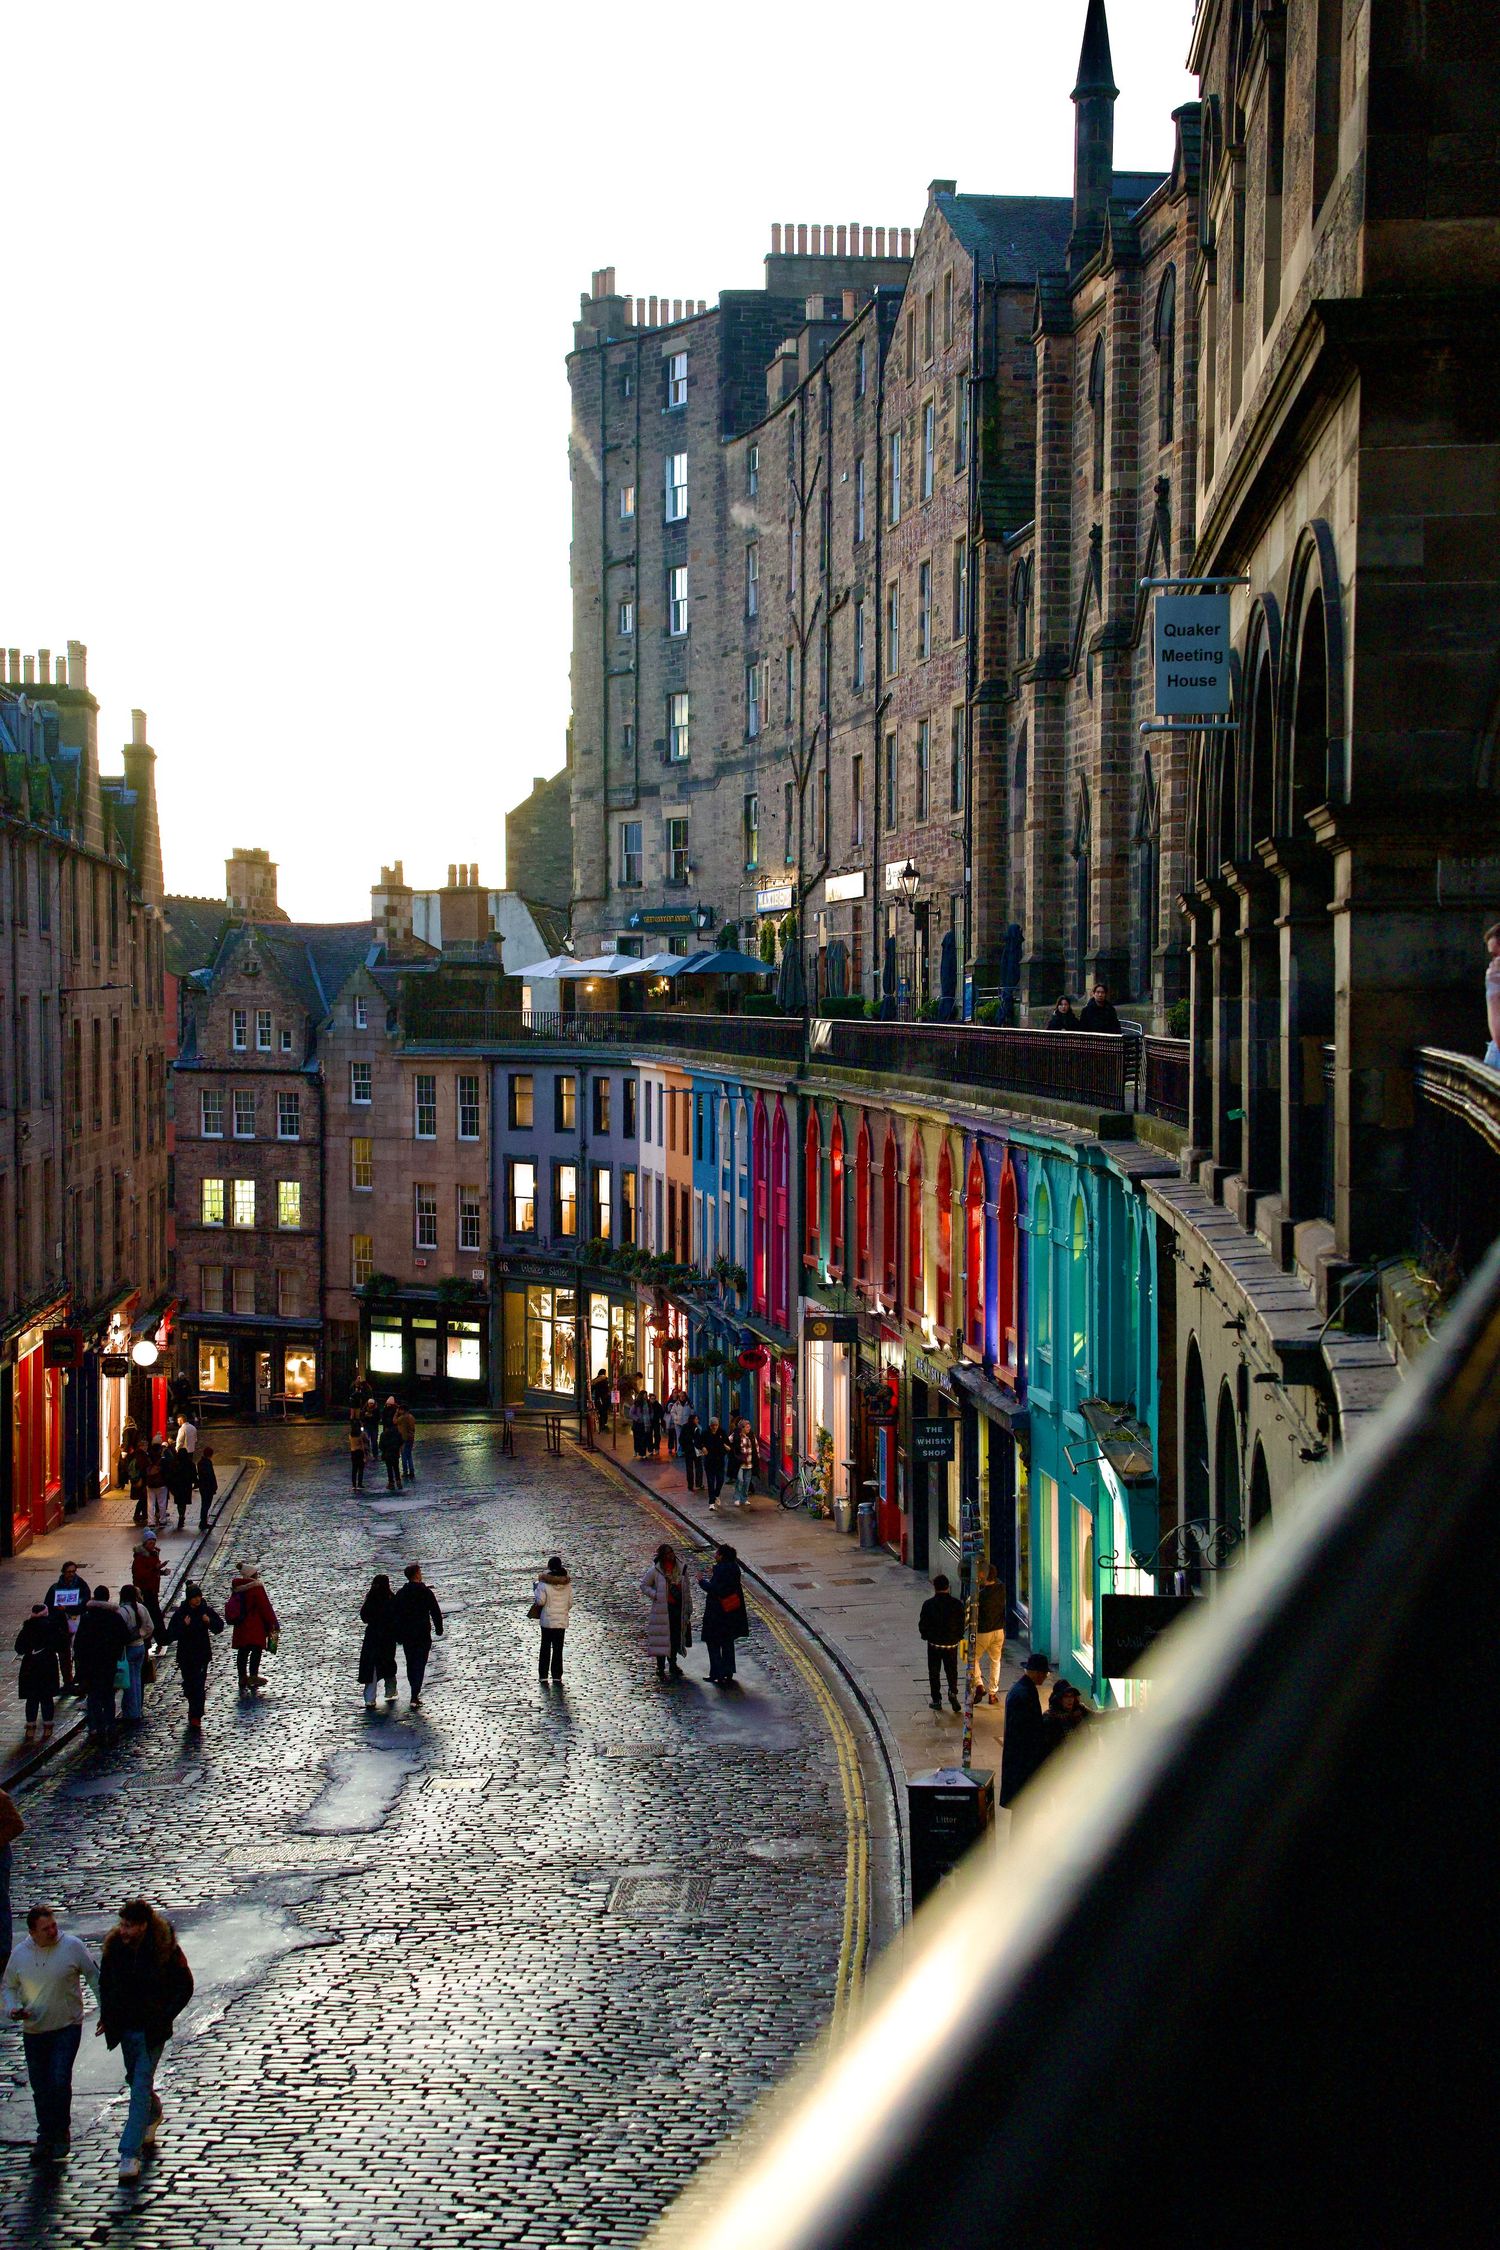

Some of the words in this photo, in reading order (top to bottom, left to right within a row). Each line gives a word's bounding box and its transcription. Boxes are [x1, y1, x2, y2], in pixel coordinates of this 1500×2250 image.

[1163, 624, 1221, 638] Quaker
[1162, 649, 1224, 664] Meeting
[1167, 674, 1217, 687] House
[935, 1815, 958, 1824] Litter
